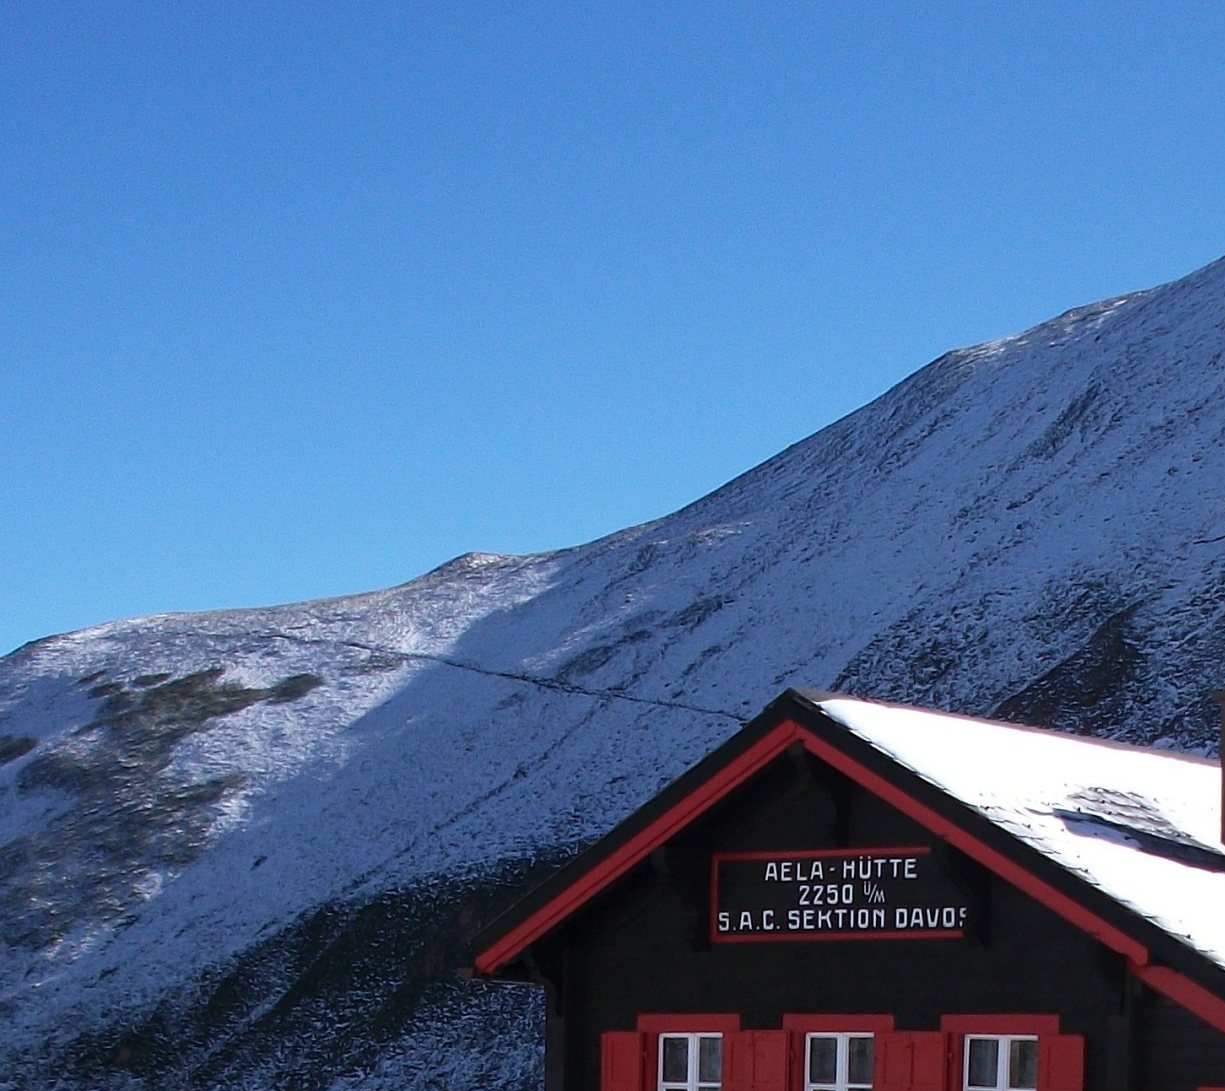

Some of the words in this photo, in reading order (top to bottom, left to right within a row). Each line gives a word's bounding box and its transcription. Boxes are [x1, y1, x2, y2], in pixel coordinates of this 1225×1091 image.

[799, 883, 854, 905] 2250
[718, 910, 781, 931] S.A.C.
[788, 908, 886, 930] SEKTION
